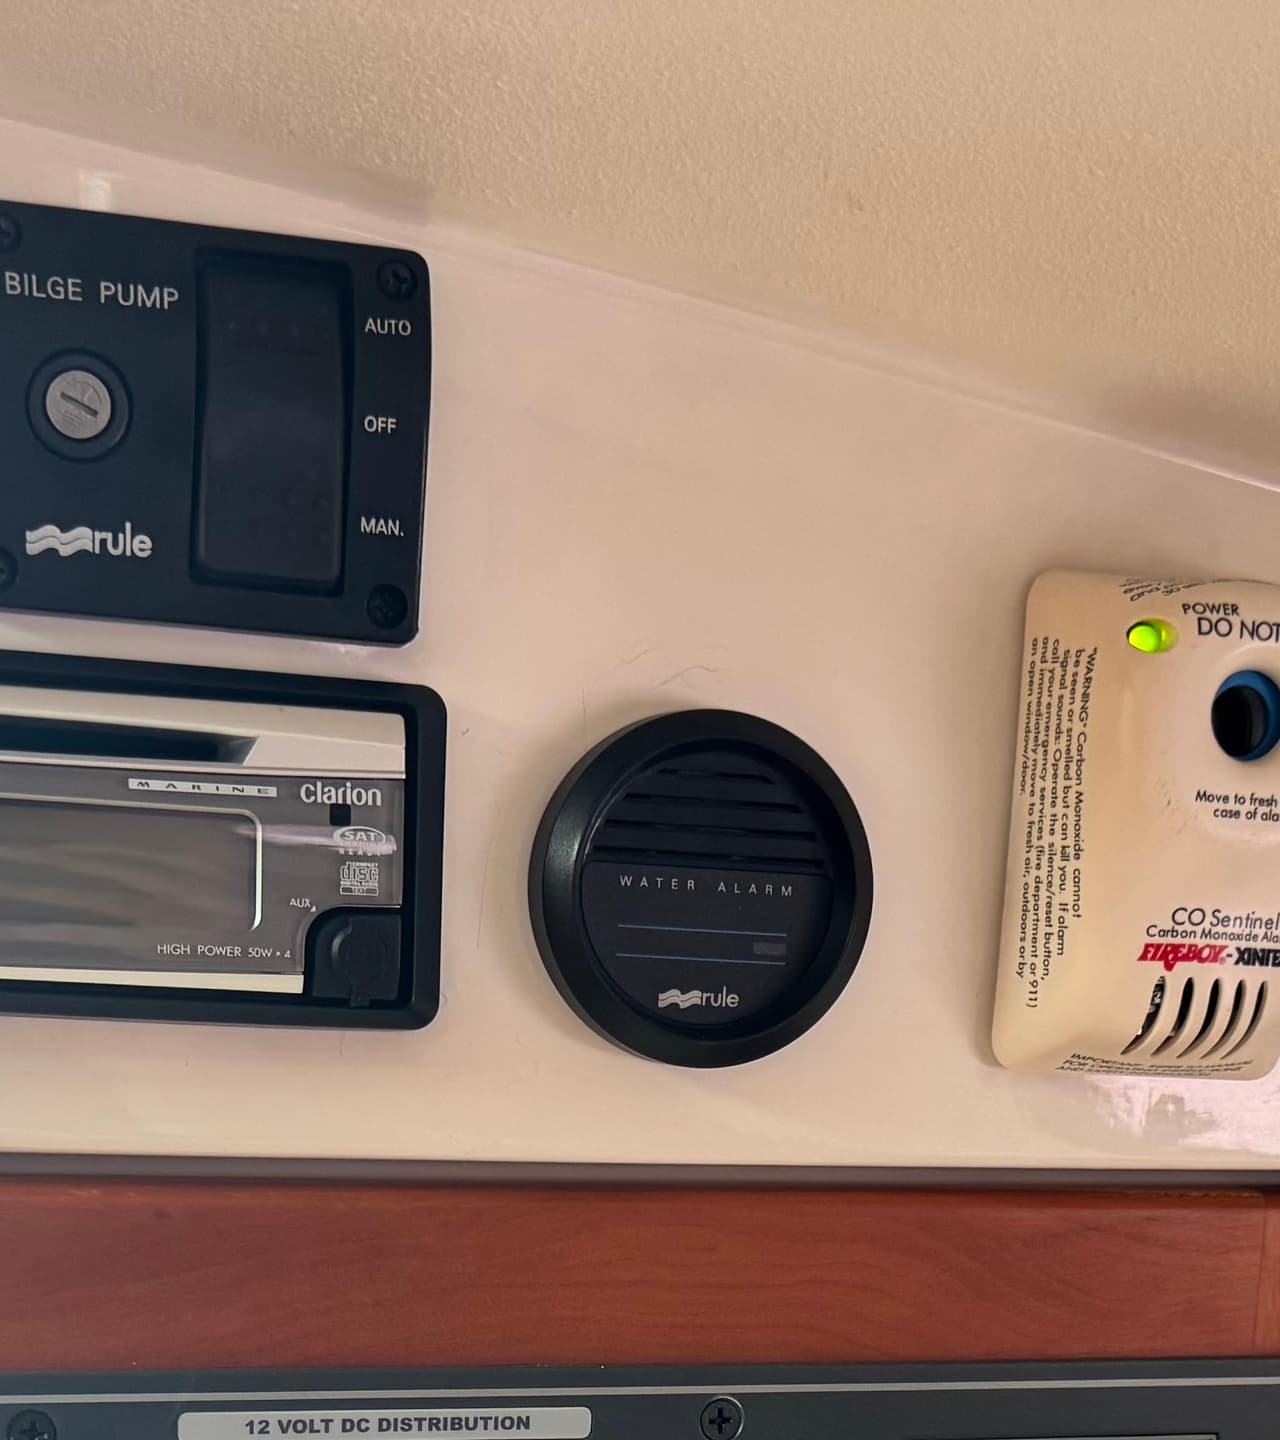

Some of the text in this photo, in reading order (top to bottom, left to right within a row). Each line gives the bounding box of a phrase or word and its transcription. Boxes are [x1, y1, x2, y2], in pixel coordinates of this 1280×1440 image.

[4, 271, 179, 310] BILGE PUMP
[364, 317, 412, 336] AUTO
[364, 416, 397, 434] OFF
[360, 516, 404, 536] MAN.
[94, 522, 153, 558] rule
[1182, 603, 1239, 616] POWER
[1197, 617, 1232, 637] DO
[1074, 732, 1088, 786] Carbon
[137, 781, 269, 795] MARINE
[300, 782, 382, 807] Clarion
[1196, 790, 1229, 803] Move
[1234, 793, 1246, 804] to
[1249, 794, 1277, 808] fresh
[1213, 808, 1240, 819] case
[1245, 809, 1257, 820] of
[620, 876, 793, 896] WATER ALARM
[290, 898, 311, 908] AUX
[1171, 908, 1280, 930] CO Sentinel
[1146, 925, 1196, 939] Carbon
[1200, 928, 1258, 942] Monoxide
[157, 944, 272, 958] HIGH POWER 50W
[701, 986, 739, 1007] rule
[245, 1415, 531, 1435] 12 VOLT DC DISTRIBUTION
